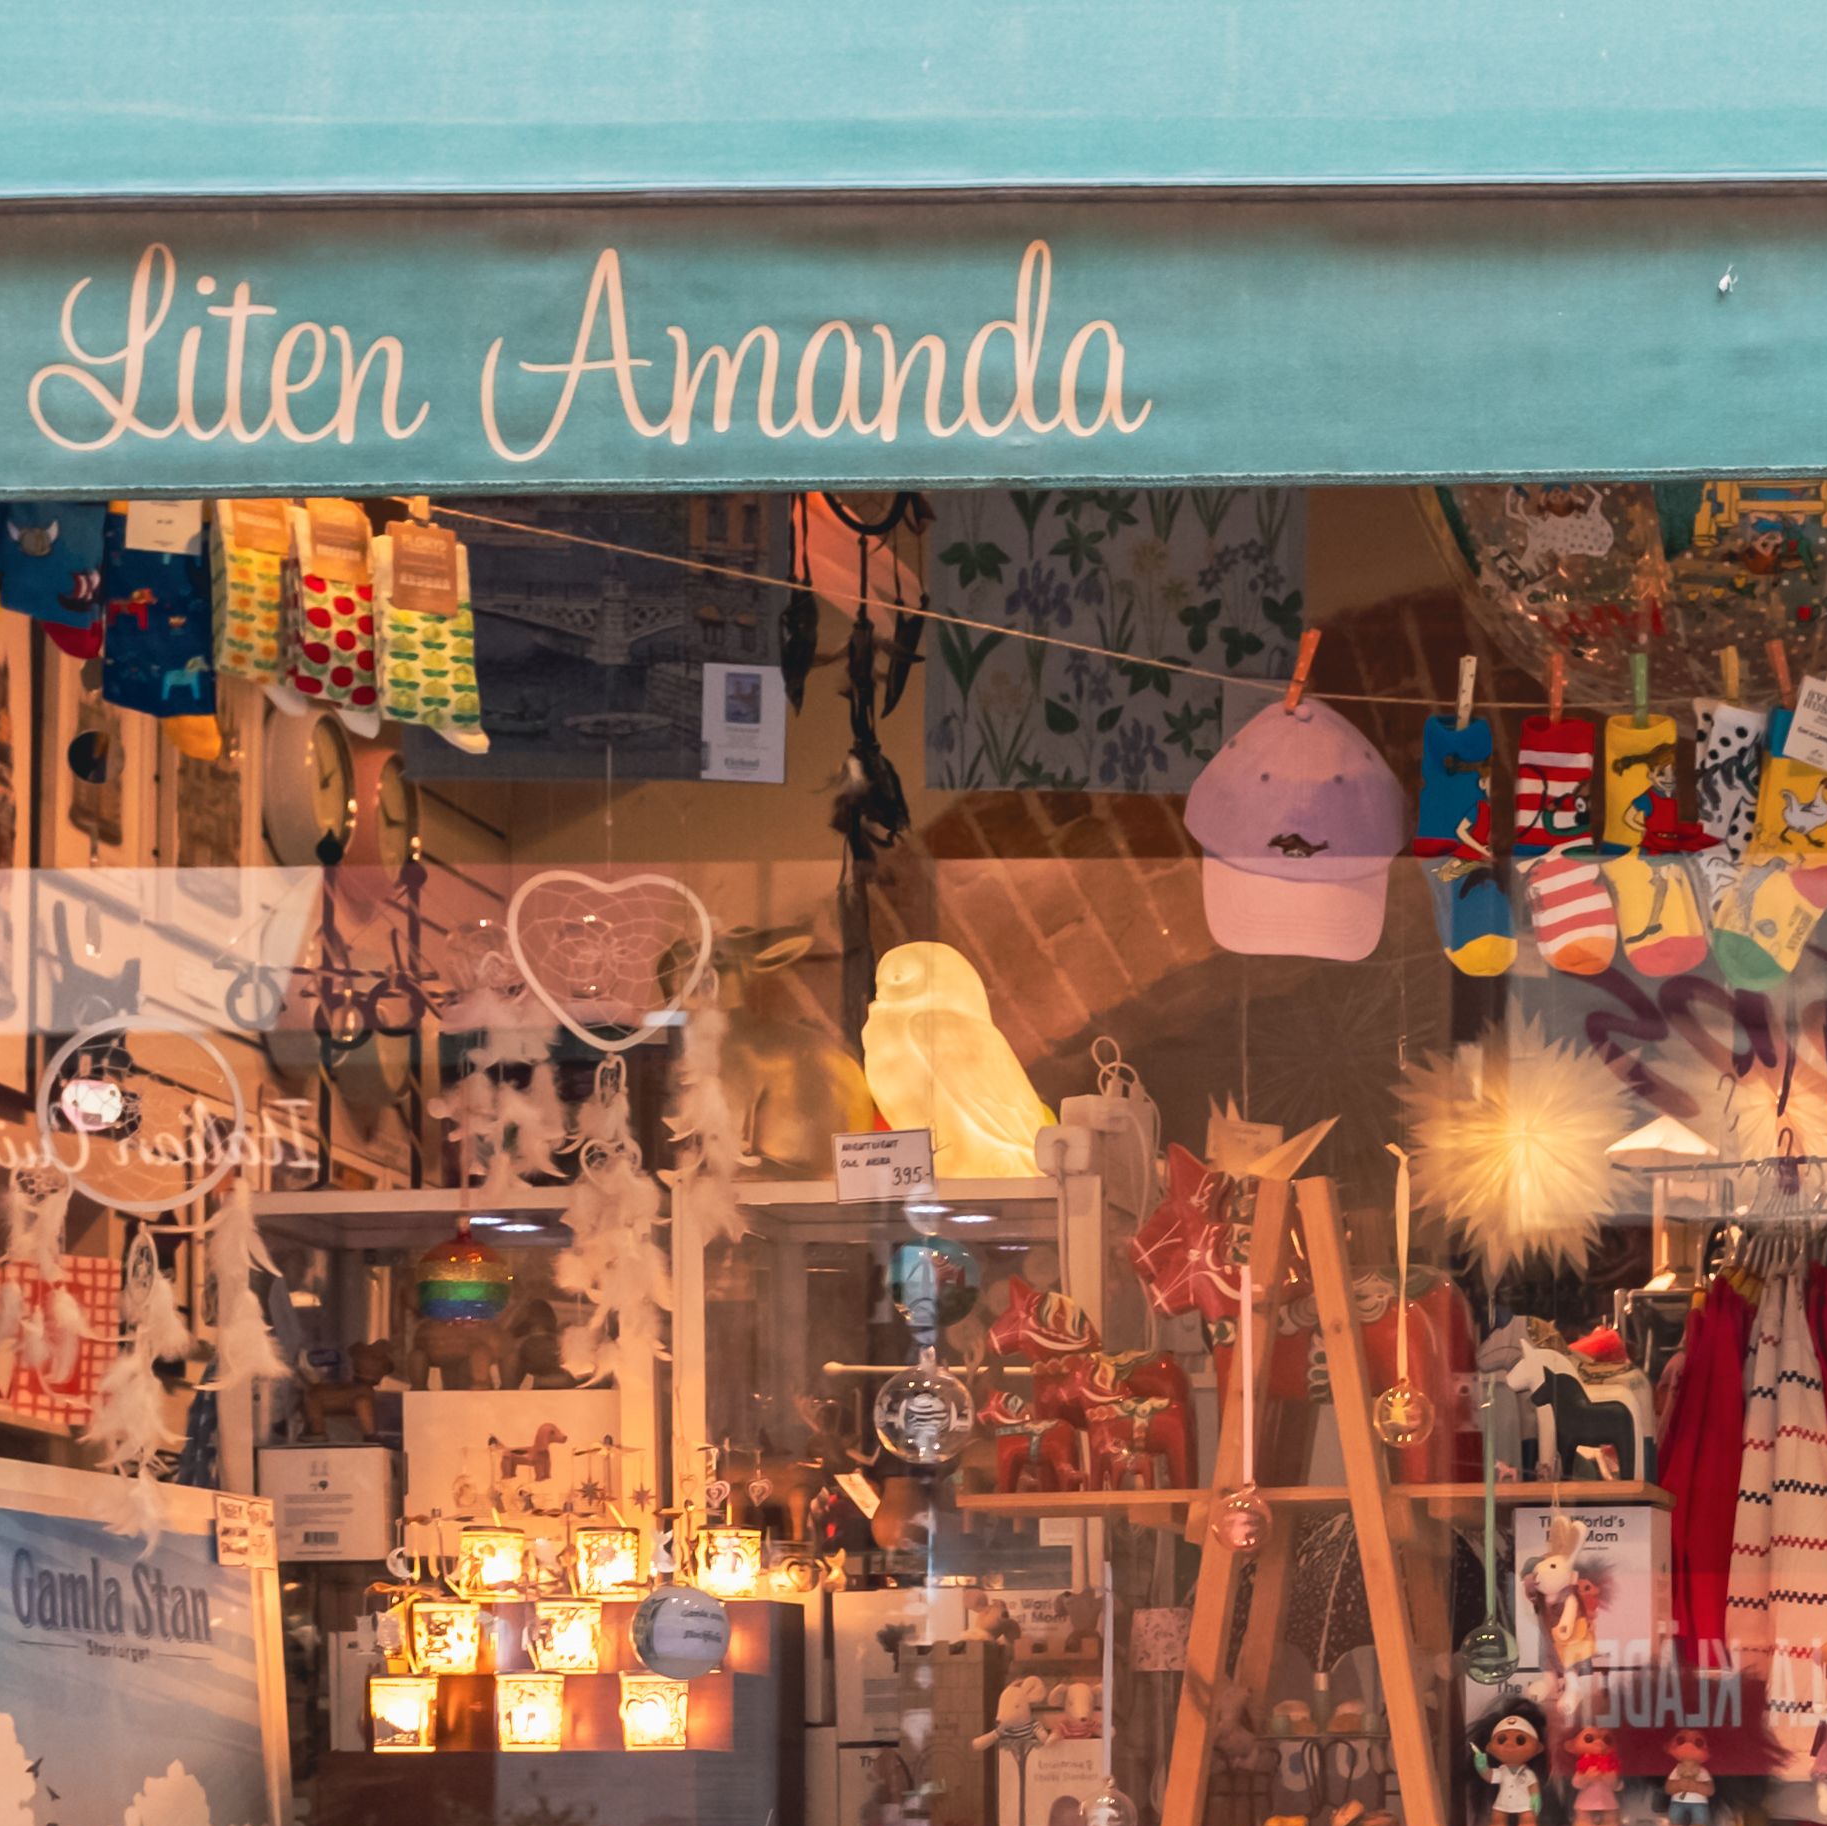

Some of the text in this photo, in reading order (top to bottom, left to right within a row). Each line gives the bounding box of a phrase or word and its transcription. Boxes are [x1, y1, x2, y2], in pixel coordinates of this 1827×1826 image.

[28, 239, 1153, 462] Liten Amanda
[11, 1547, 212, 1642] Gamla Stan
